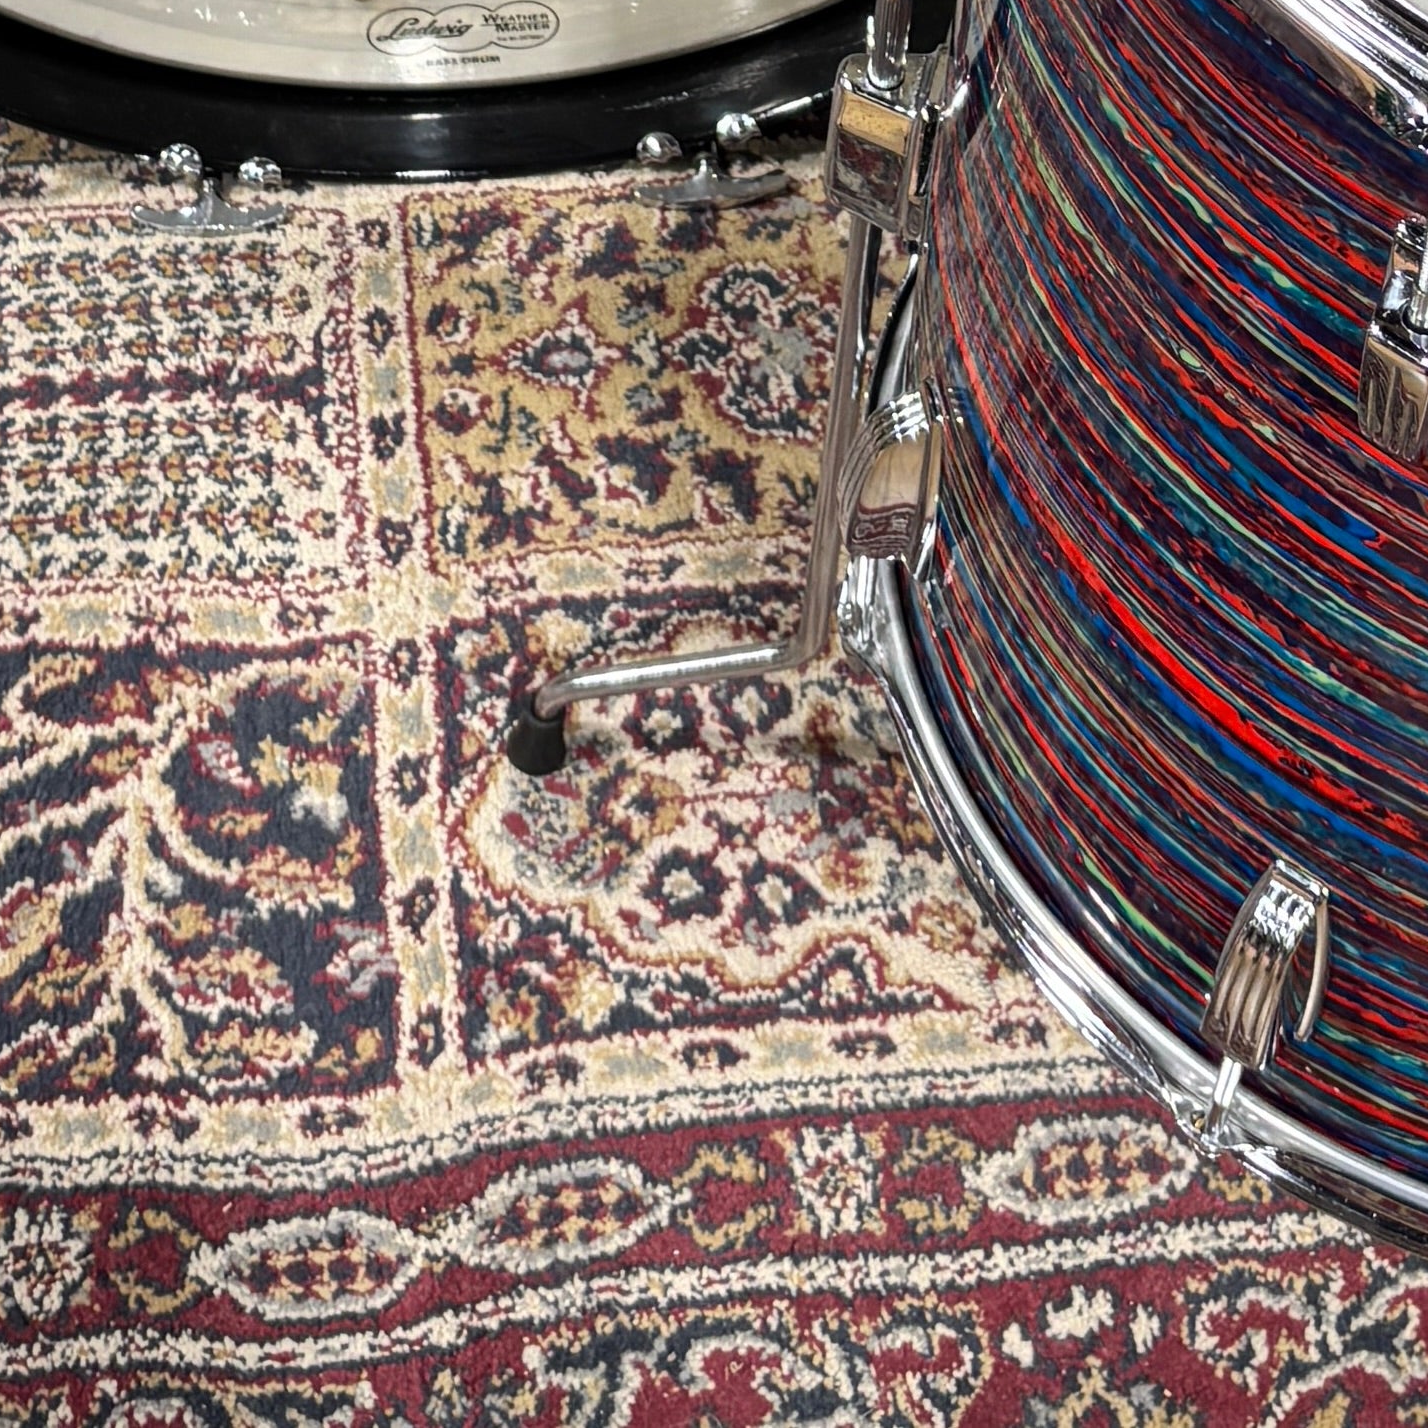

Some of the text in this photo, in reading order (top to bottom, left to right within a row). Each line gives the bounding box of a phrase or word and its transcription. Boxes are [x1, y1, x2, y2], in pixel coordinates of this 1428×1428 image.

[482, 13, 550, 24] WEATHER
[376, 17, 473, 42] Ludwig
[495, 21, 551, 33] MASTER
